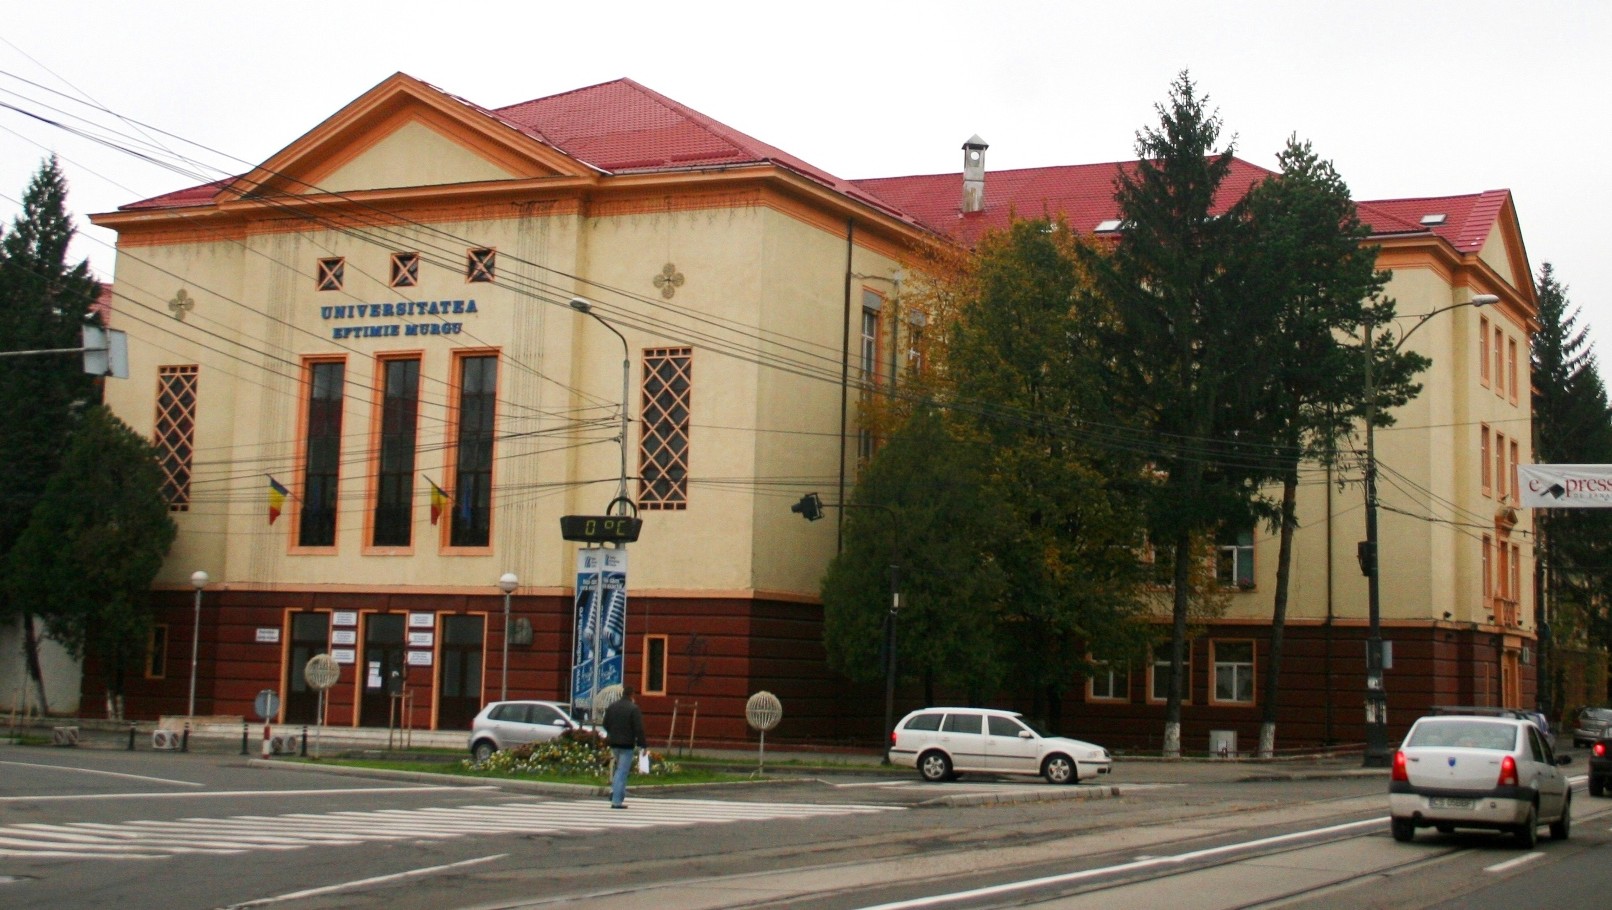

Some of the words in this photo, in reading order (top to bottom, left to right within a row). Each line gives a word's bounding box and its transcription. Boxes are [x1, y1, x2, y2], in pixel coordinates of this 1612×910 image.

[321, 300, 478, 320] UNIVERSITATEA
[332, 325, 400, 339] EFTIMIE
[405, 322, 463, 336] MURGU
[585, 520, 596, 535] 0
